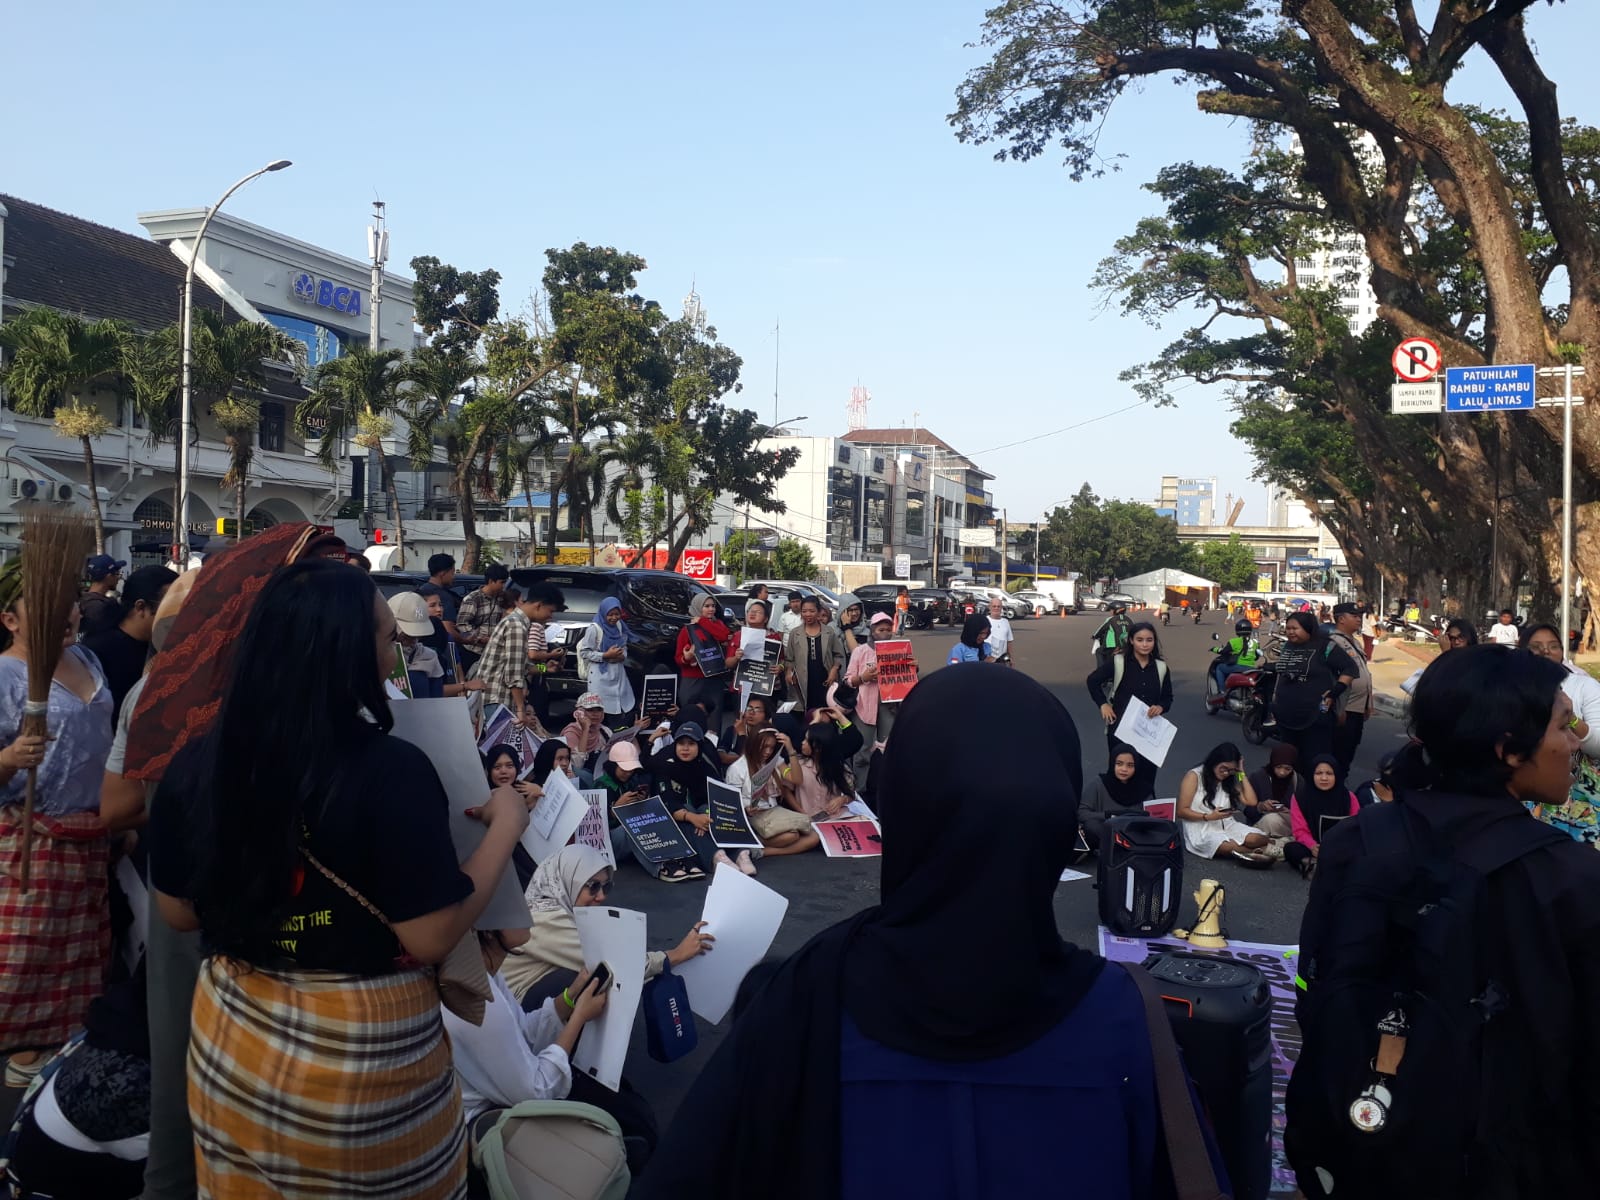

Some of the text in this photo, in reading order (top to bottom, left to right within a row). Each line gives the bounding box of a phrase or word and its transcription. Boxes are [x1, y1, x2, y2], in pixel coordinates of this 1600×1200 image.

[317, 279, 361, 316] BCA
[1463, 370, 1518, 381] PATUHILAH
[1450, 384, 1485, 394] RAMBU
[1495, 382, 1530, 392] RAMBU
[1459, 396, 1522, 407] LALU LINTAS
[880, 663, 912, 676] BERHAK
[629, 815, 668, 829] PEREMPUAN
[309, 910, 333, 928] THE
[669, 997, 683, 1038] mizone
